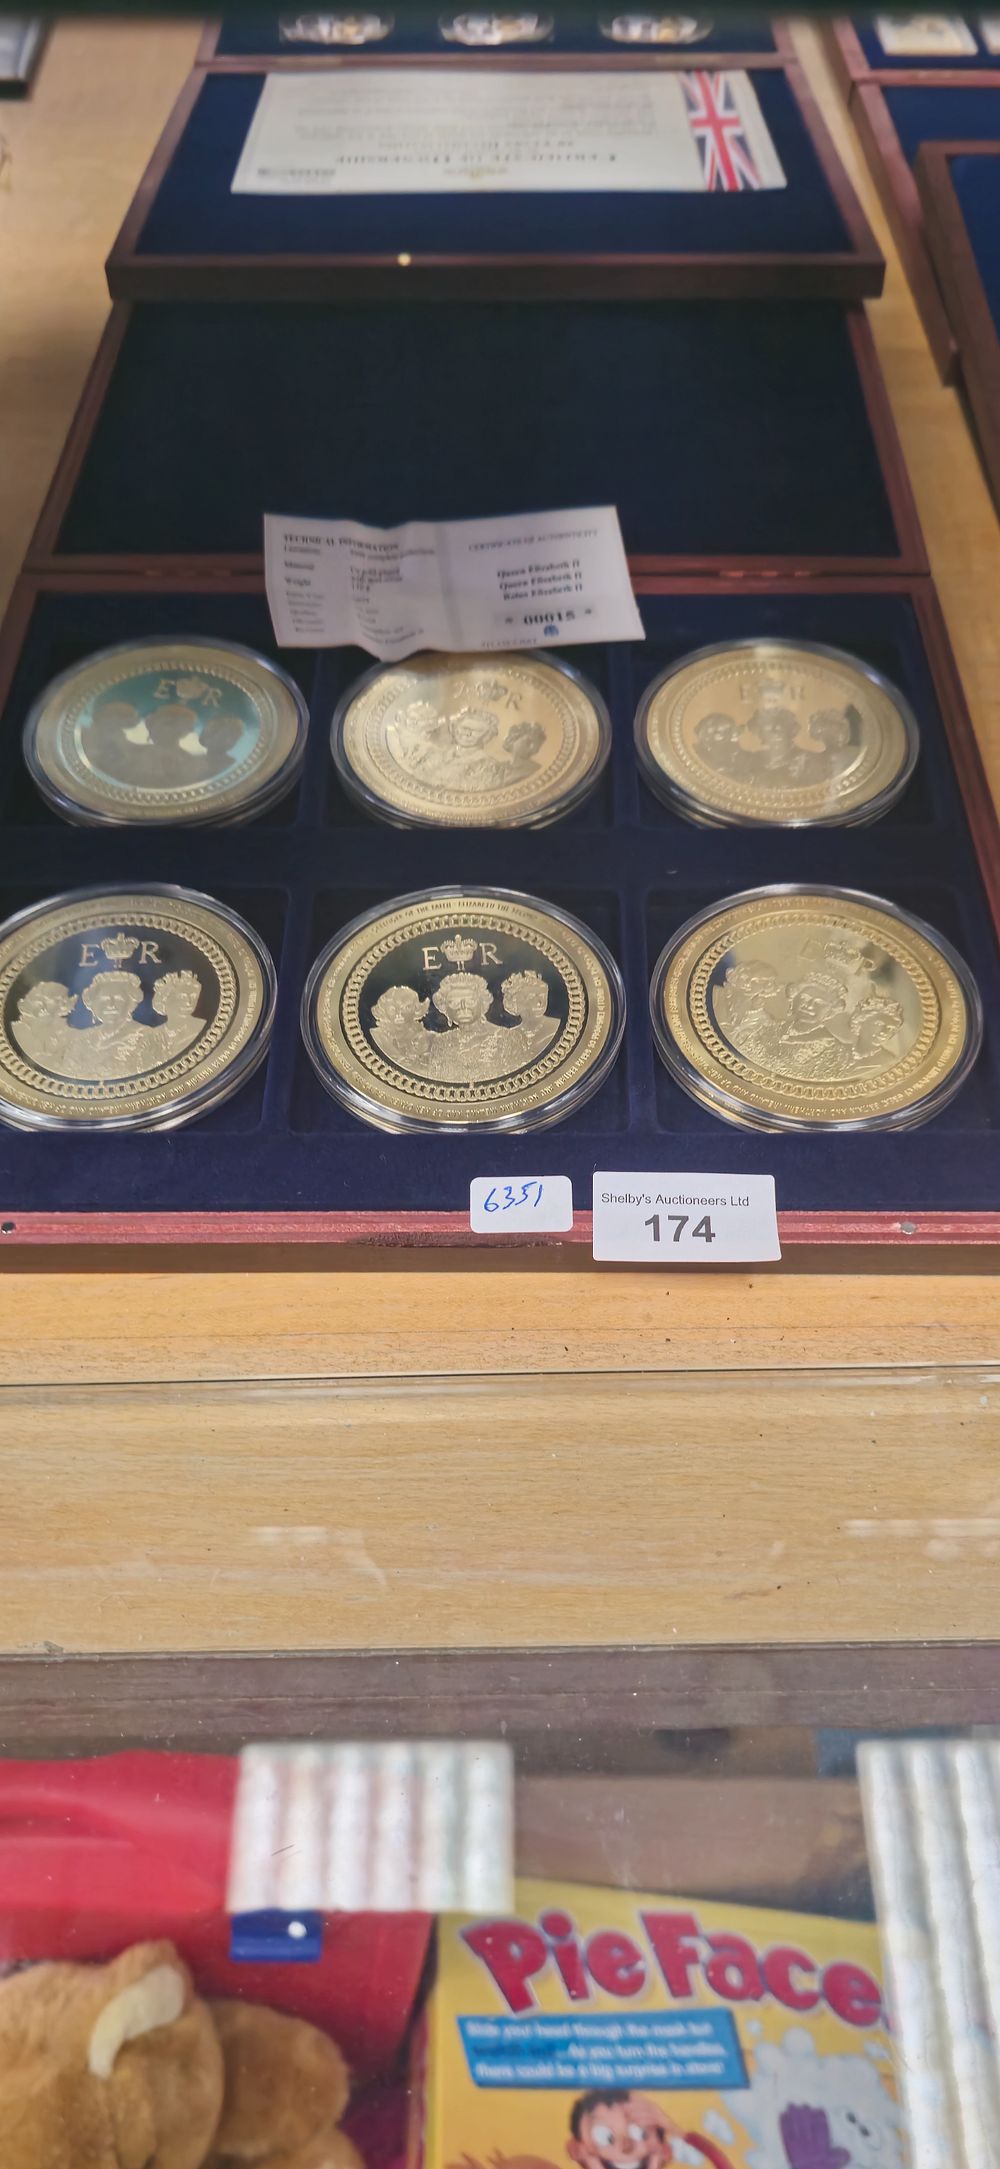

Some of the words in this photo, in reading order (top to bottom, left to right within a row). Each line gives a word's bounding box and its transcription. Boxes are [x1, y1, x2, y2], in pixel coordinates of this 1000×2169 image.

[523, 609, 576, 626] 00015
[138, 940, 163, 965] R
[422, 946, 443, 971] E
[478, 942, 504, 966] R
[482, 1180, 544, 1213] 6351
[601, 1192, 652, 1208] Shelby's
[655, 1193, 727, 1207] Auctioneers
[730, 1195, 750, 1207] Ltd
[643, 1213, 717, 1244] 174
